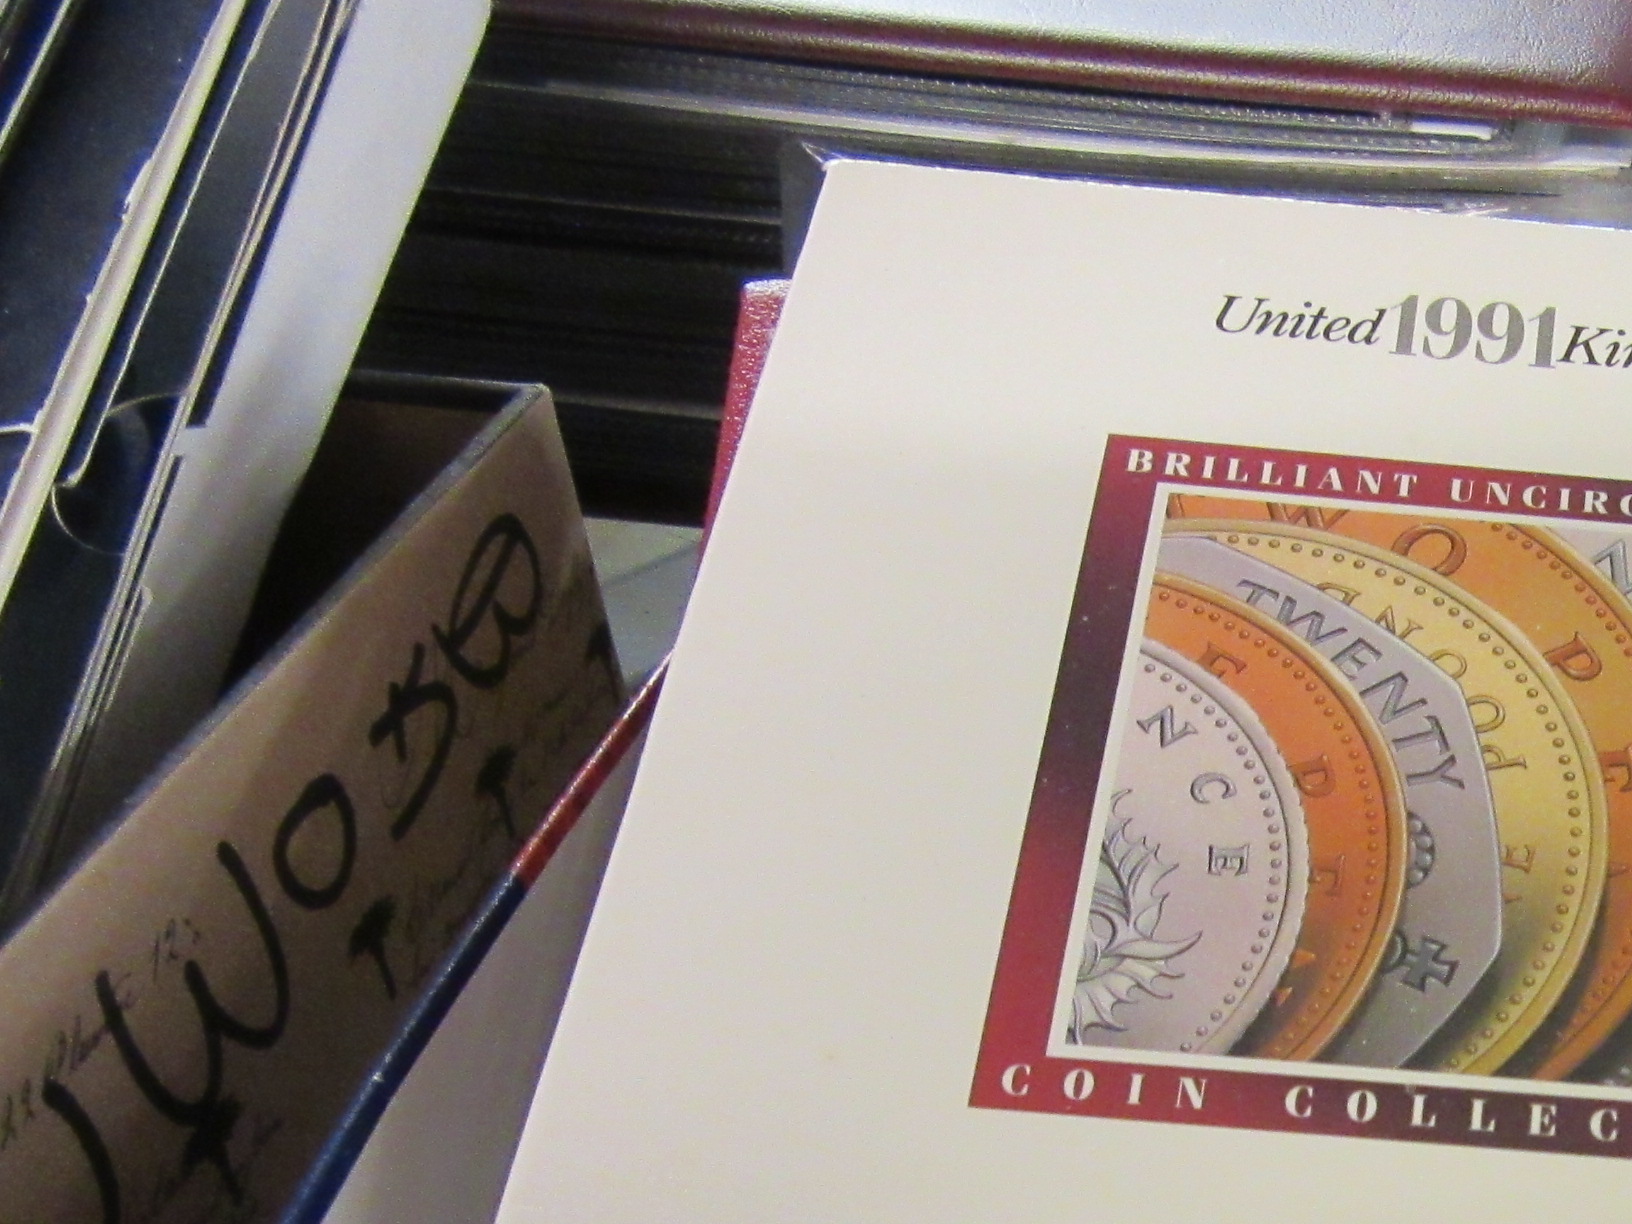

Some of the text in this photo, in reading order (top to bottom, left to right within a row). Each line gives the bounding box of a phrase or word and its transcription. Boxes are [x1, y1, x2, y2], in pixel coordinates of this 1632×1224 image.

[1213, 293, 1386, 346] United
[1388, 293, 1559, 371] 1991
[1125, 447, 1419, 499] BRILLIANT
[1235, 579, 1466, 790] TWENTY
[999, 1062, 1209, 1111] COIN
